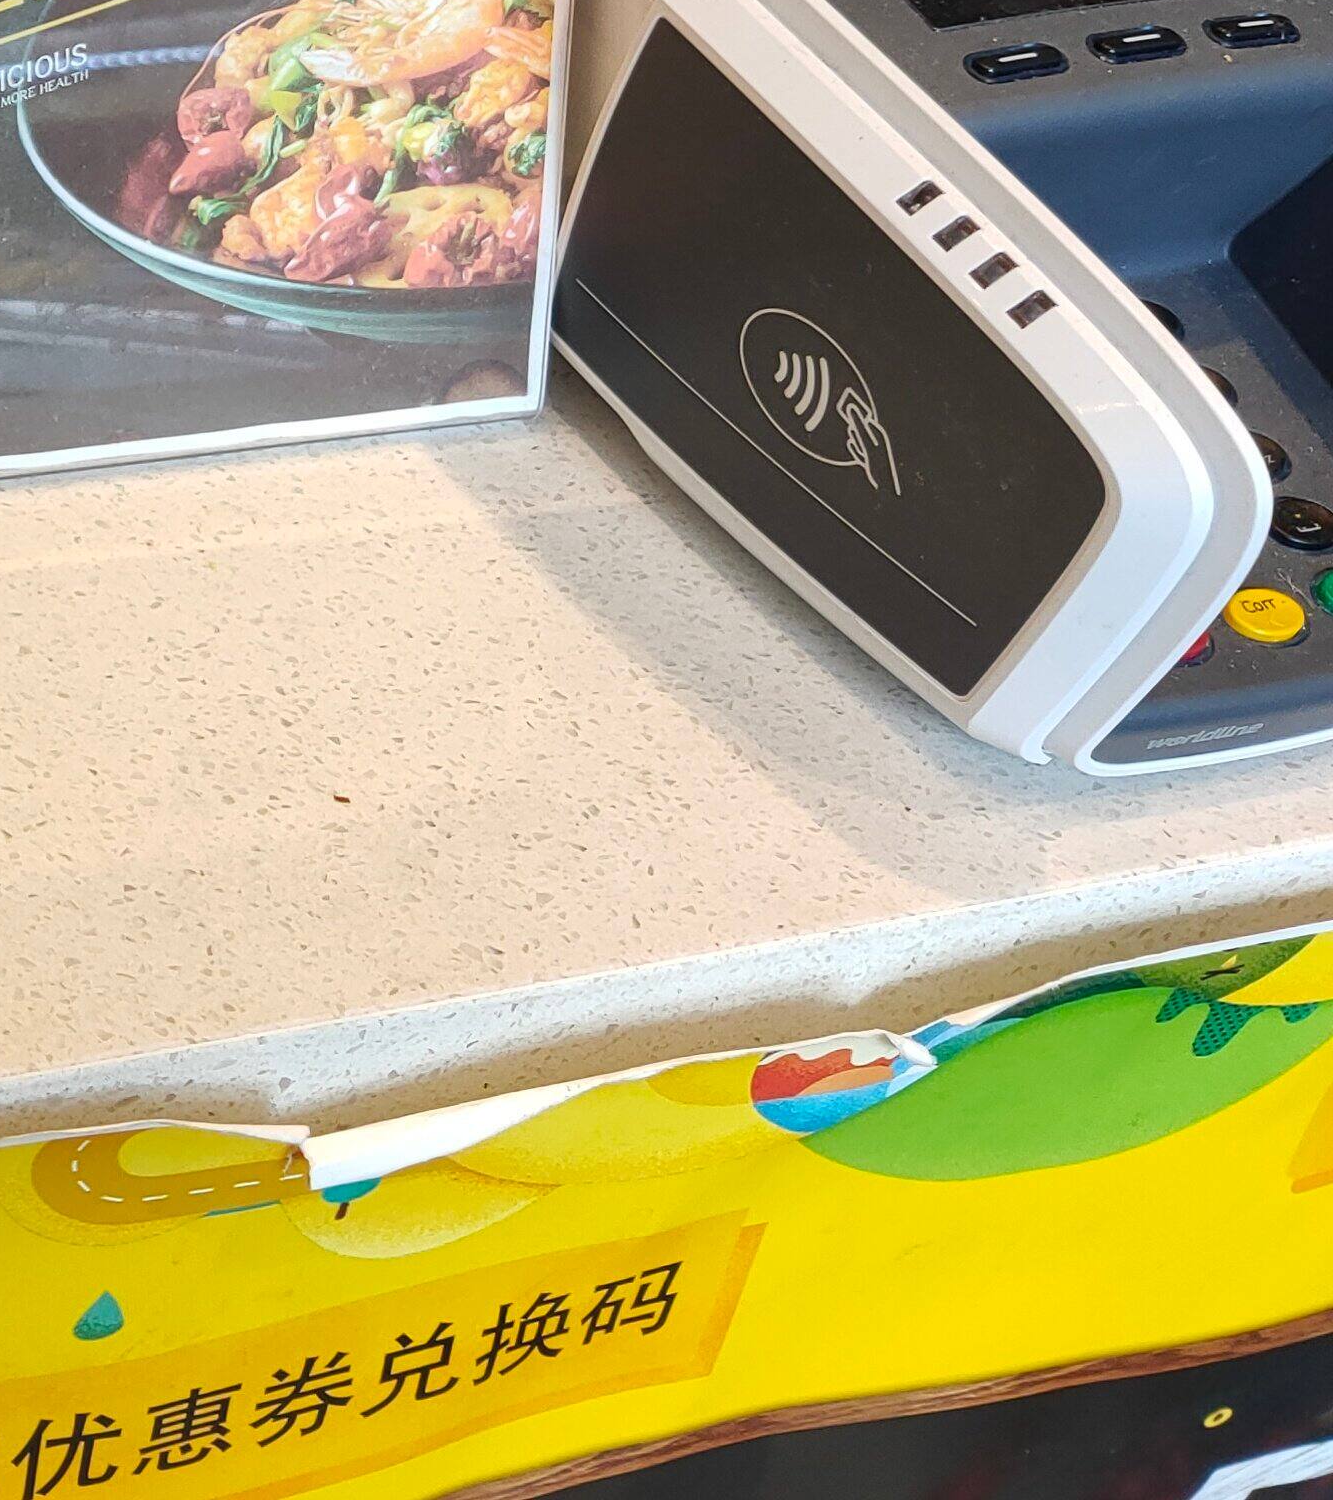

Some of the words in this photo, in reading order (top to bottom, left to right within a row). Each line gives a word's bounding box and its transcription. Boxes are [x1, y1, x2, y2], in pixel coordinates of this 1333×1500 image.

[0, 86, 36, 108] MORE
[39, 69, 89, 95] HEALTH
[1241, 598, 1276, 614] Corr
[1147, 723, 1265, 750] worldline
